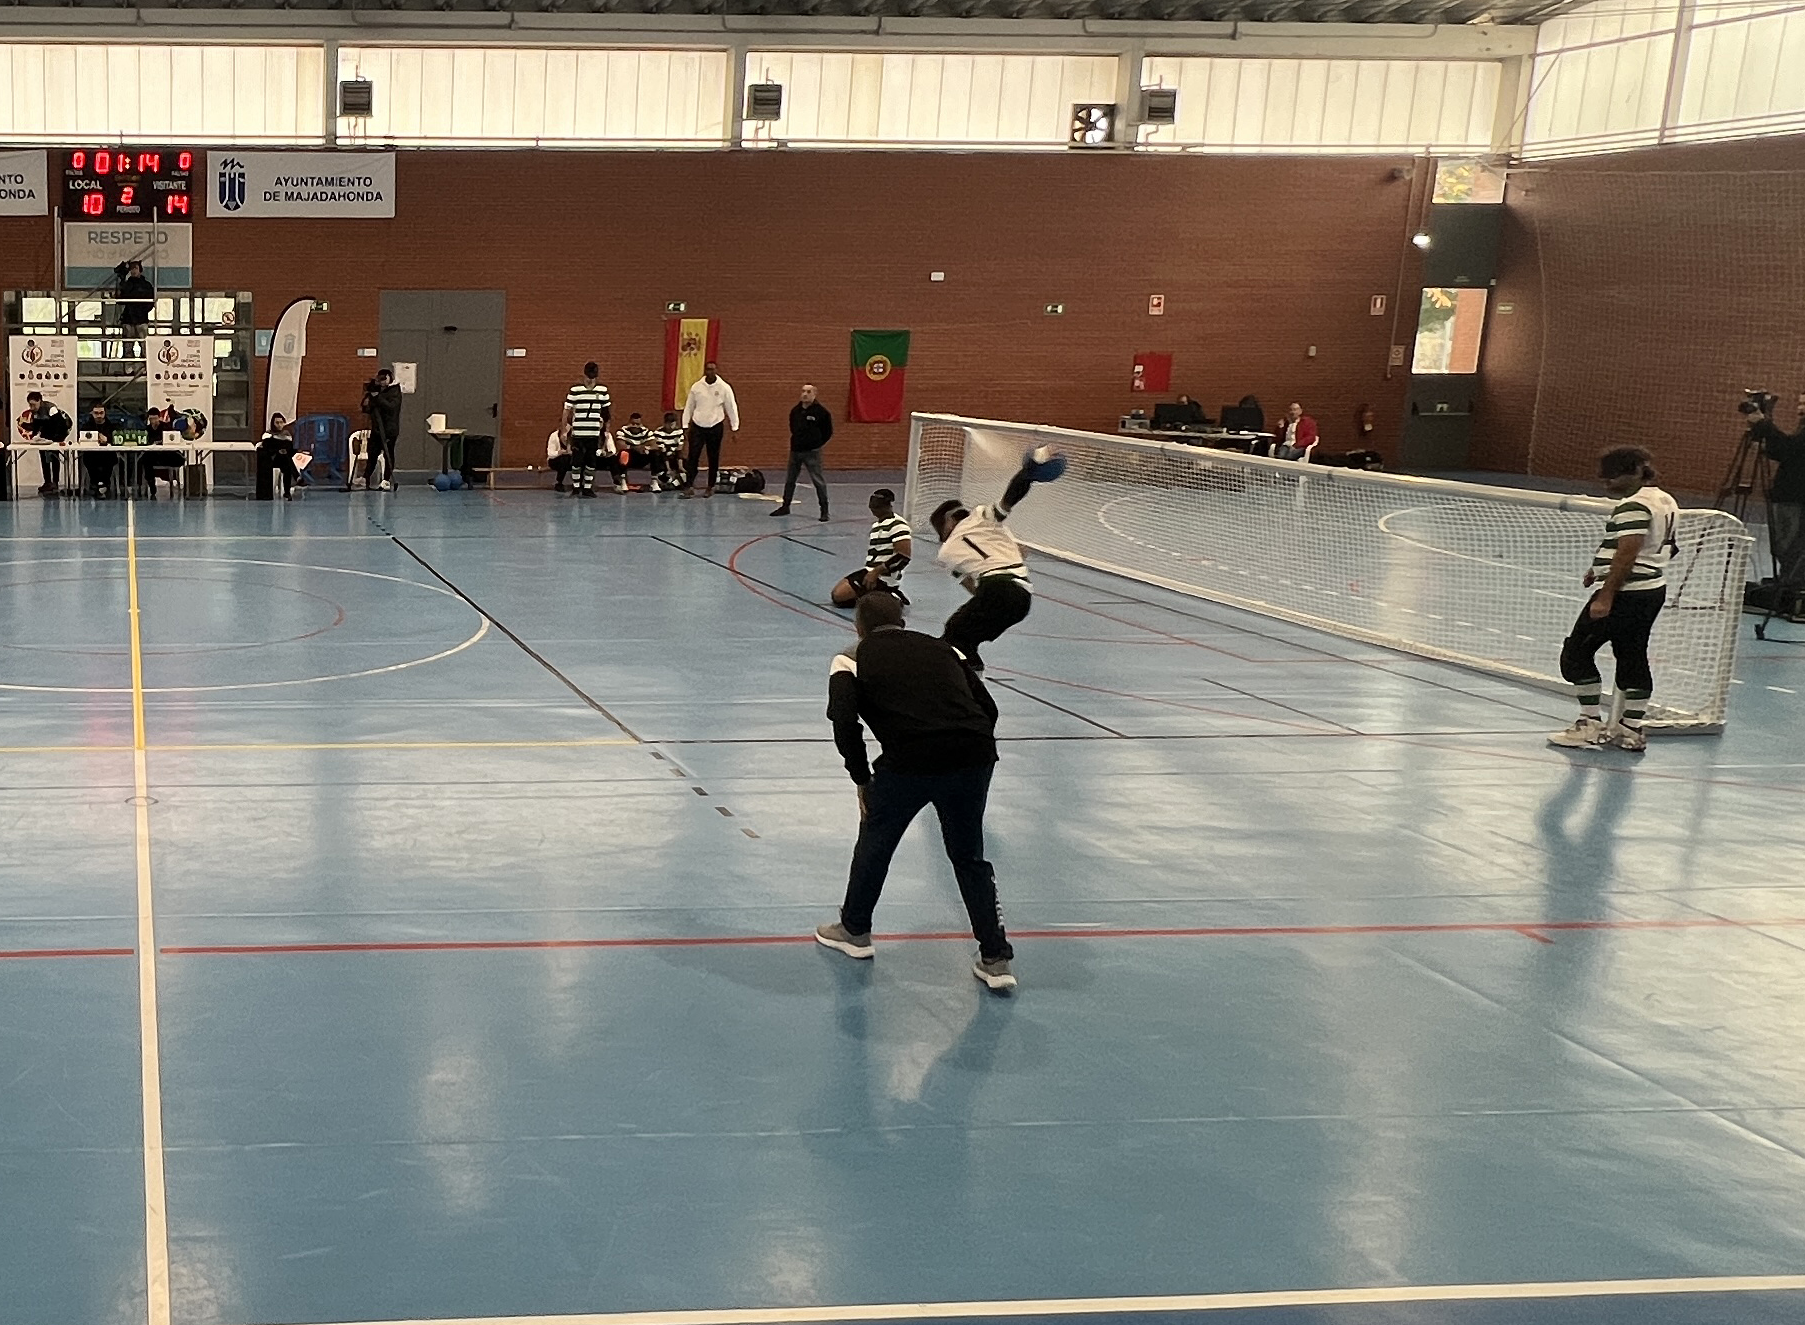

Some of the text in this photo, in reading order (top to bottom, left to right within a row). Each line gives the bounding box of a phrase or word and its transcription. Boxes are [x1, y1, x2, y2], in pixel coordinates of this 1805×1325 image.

[73, 152, 85, 169] 0
[95, 152, 160, 174] 01:14
[179, 152, 192, 169] 0
[69, 180, 103, 190] LOCAL
[274, 176, 373, 187] AYUNTAMIENTO
[120, 186, 134, 204] 2
[263, 191, 383, 202] DE MAJADAHONDA
[83, 194, 104, 214] 10
[167, 195, 188, 214] 14
[88, 231, 168, 244] RESPETO
[113, 435, 124, 445] 10
[137, 435, 147, 445] 14
